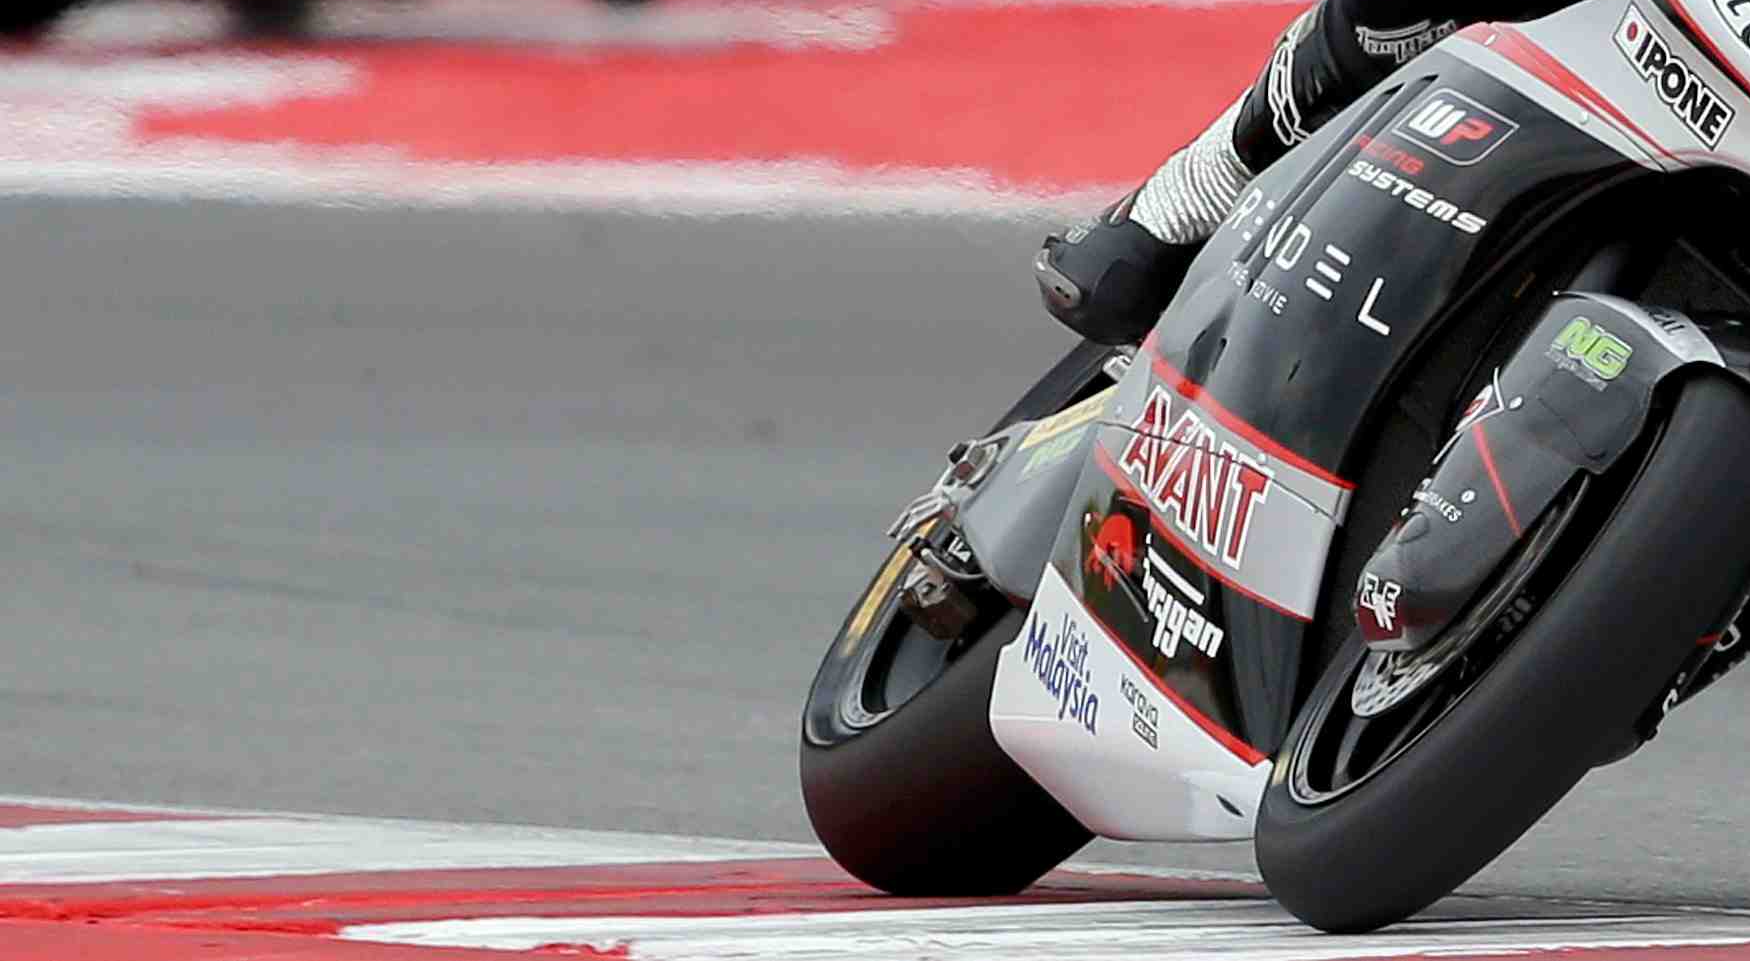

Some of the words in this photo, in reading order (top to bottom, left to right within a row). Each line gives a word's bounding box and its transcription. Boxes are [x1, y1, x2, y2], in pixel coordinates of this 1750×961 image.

[1408, 99, 1494, 145] WP
[1632, 28, 1730, 146] IPONE
[1349, 159, 1488, 234] SYSTEMS
[1551, 316, 1633, 380] NG
[1119, 385, 1275, 570] AVANT
[1022, 610, 1101, 737] Malaysia
[1059, 612, 1091, 674] Visit
